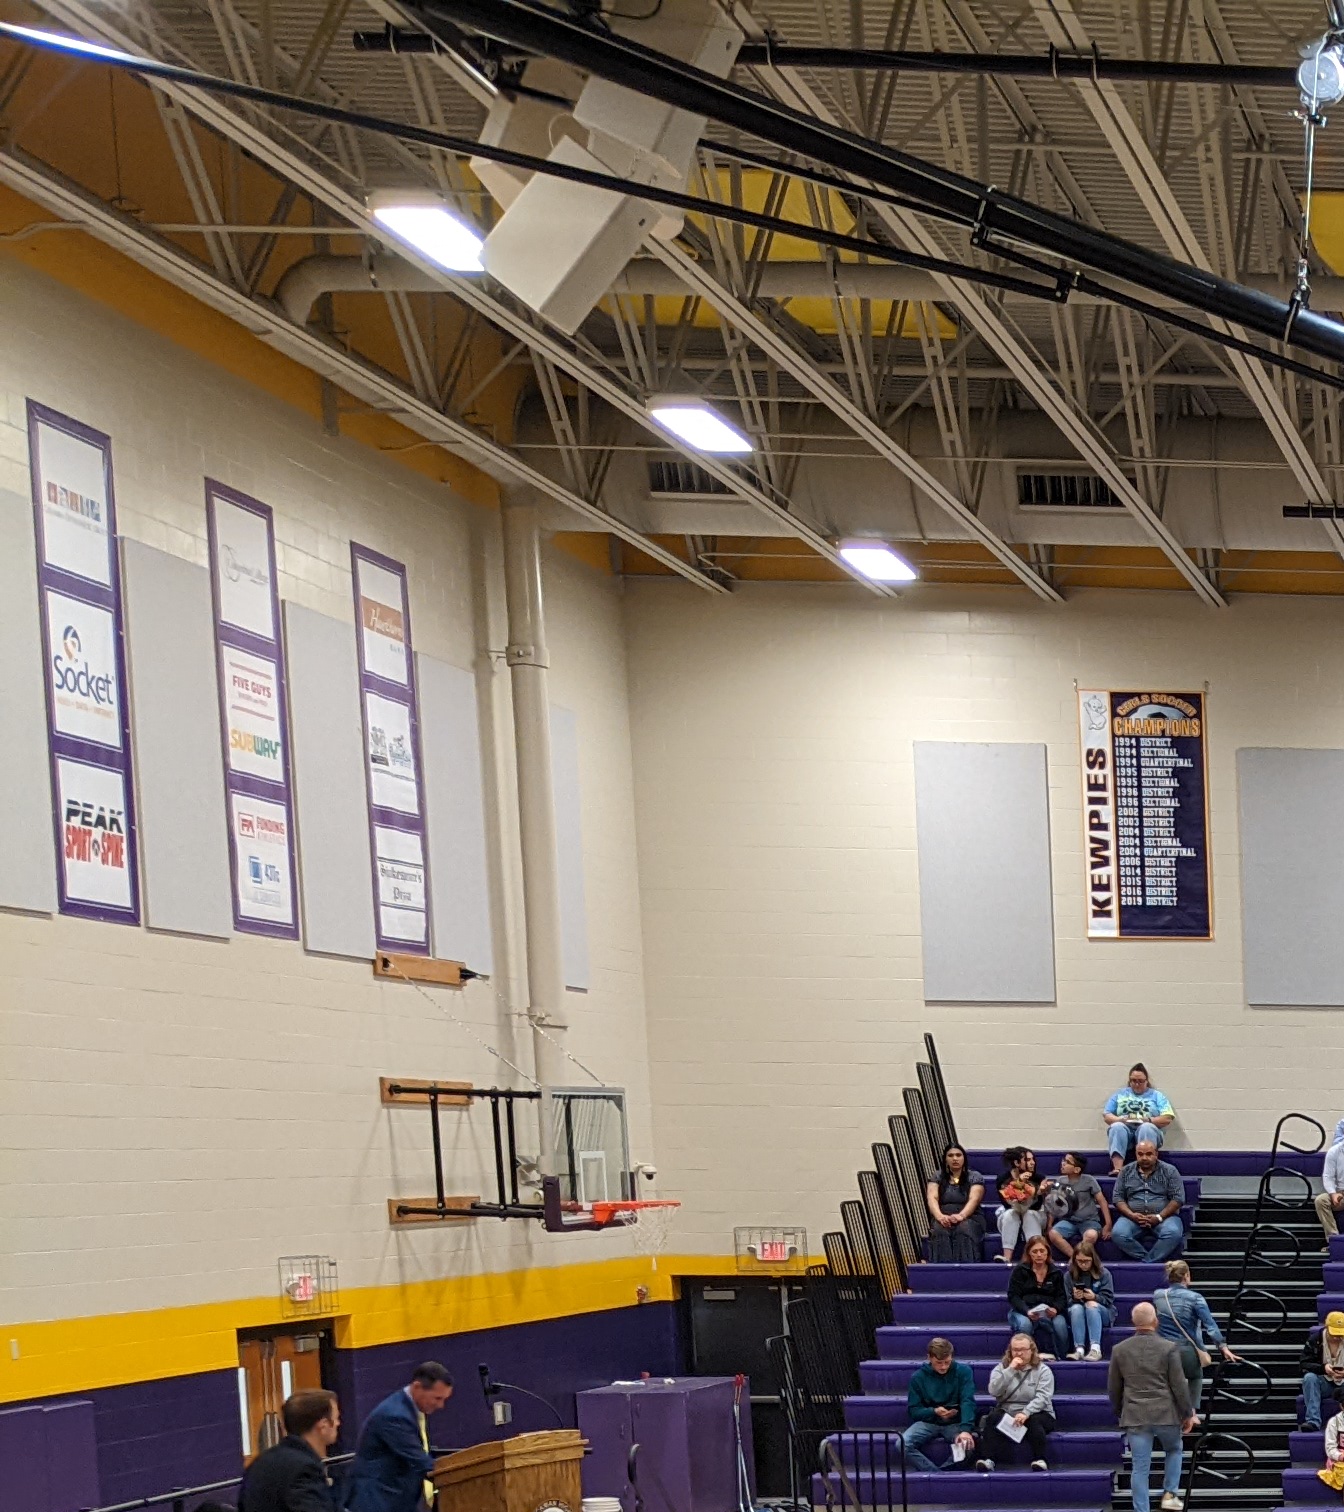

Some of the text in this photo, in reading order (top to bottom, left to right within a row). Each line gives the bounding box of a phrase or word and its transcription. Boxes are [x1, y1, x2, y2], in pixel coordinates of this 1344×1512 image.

[54, 655, 114, 705] Socket
[230, 728, 280, 760] SUBWAY
[1113, 717, 1200, 737] CHAMPIONS
[66, 799, 124, 834] PEAK
[1086, 748, 1113, 918] KEWPIES
